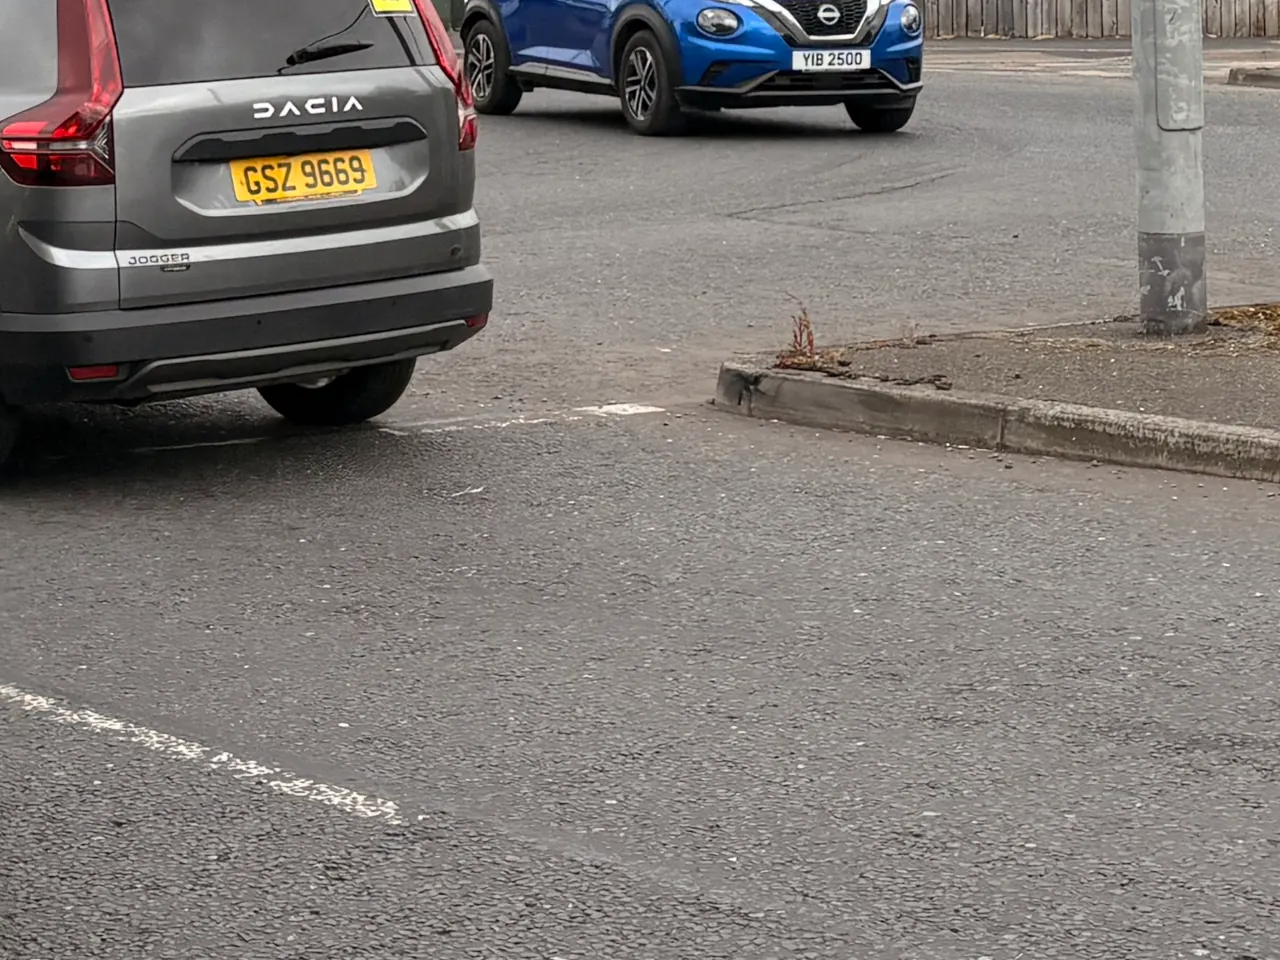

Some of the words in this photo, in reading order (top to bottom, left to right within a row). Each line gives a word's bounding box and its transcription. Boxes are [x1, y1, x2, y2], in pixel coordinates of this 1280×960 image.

[803, 53, 823, 66] YIB
[828, 52, 863, 66] 2500
[252, 96, 363, 119] DACIA
[243, 162, 296, 196] GSZ
[301, 155, 367, 189] 9669
[128, 253, 190, 265] JOGGER
